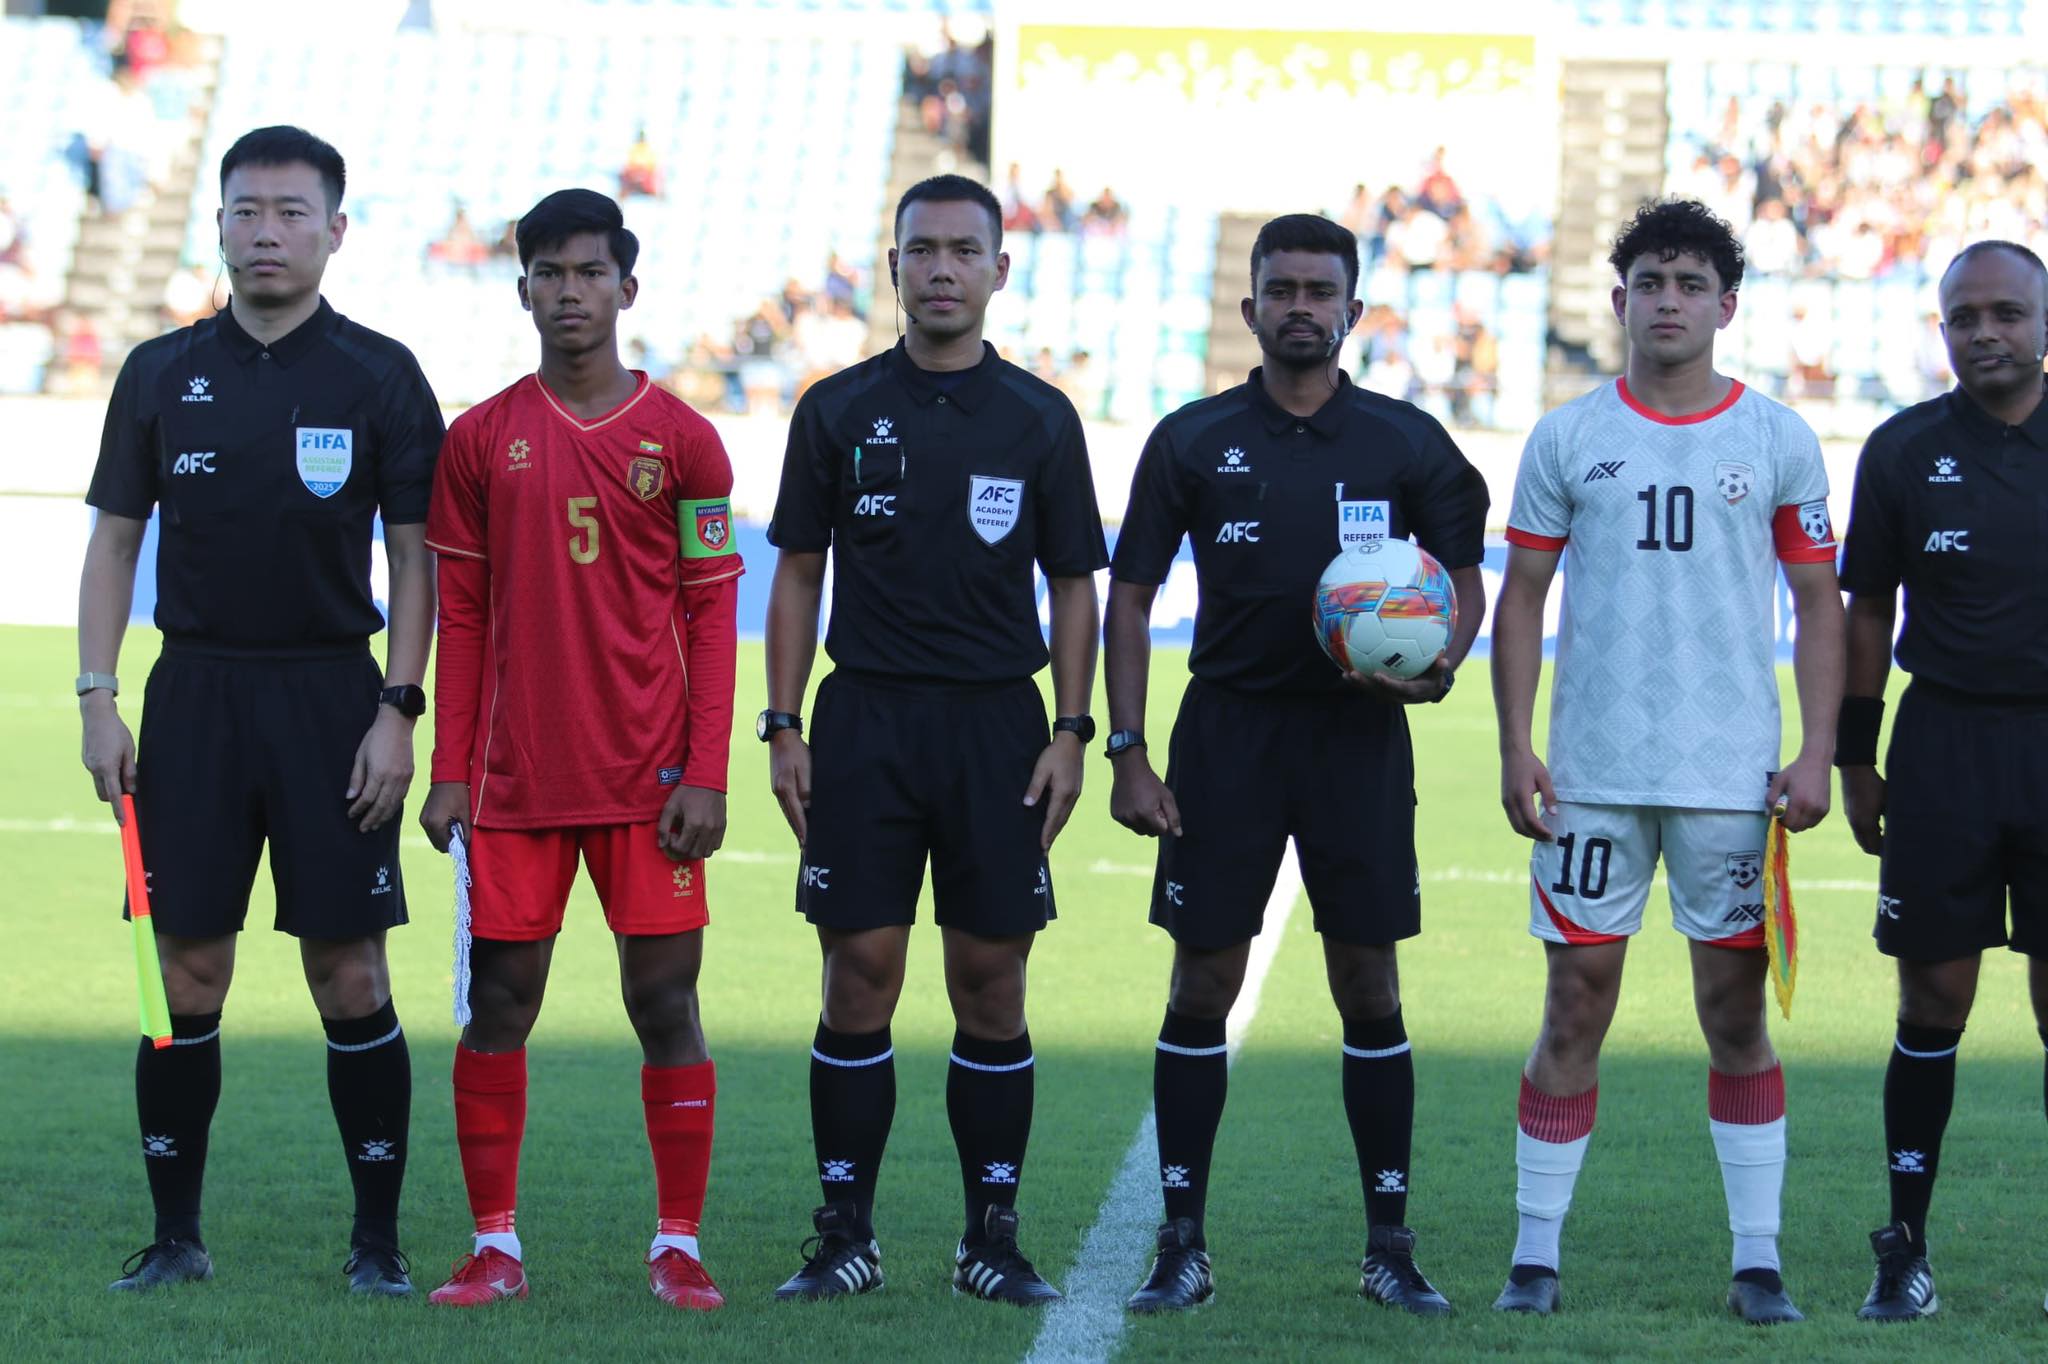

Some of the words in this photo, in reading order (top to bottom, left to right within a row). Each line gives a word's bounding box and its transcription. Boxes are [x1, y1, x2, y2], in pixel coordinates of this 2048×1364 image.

[302, 433, 347, 449] FIFA
[173, 452, 217, 474] AFC
[303, 456, 346, 465] ASSISTANT
[305, 465, 344, 474] REFEREE
[313, 483, 334, 492] 2025
[977, 485, 1015, 503] AFC
[853, 494, 897, 516] AFC
[975, 505, 1013, 516] ACADEMY
[1343, 505, 1384, 522] FIFA
[1636, 484, 1694, 552] 10
[567, 496, 600, 564] 5
[977, 518, 1009, 528] REFEREE
[1215, 521, 1260, 543] AFC
[1344, 533, 1384, 542] REFEREE
[1924, 531, 1969, 551] AFC
[1551, 831, 1612, 900] 10
[371, 885, 392, 895] KELME
[1166, 880, 1184, 905] FC
[1879, 892, 1901, 919] FC
[1890, 1164, 1924, 1172] KELME
[821, 1174, 854, 1182] KELME
[1375, 1185, 1406, 1193] KELME
